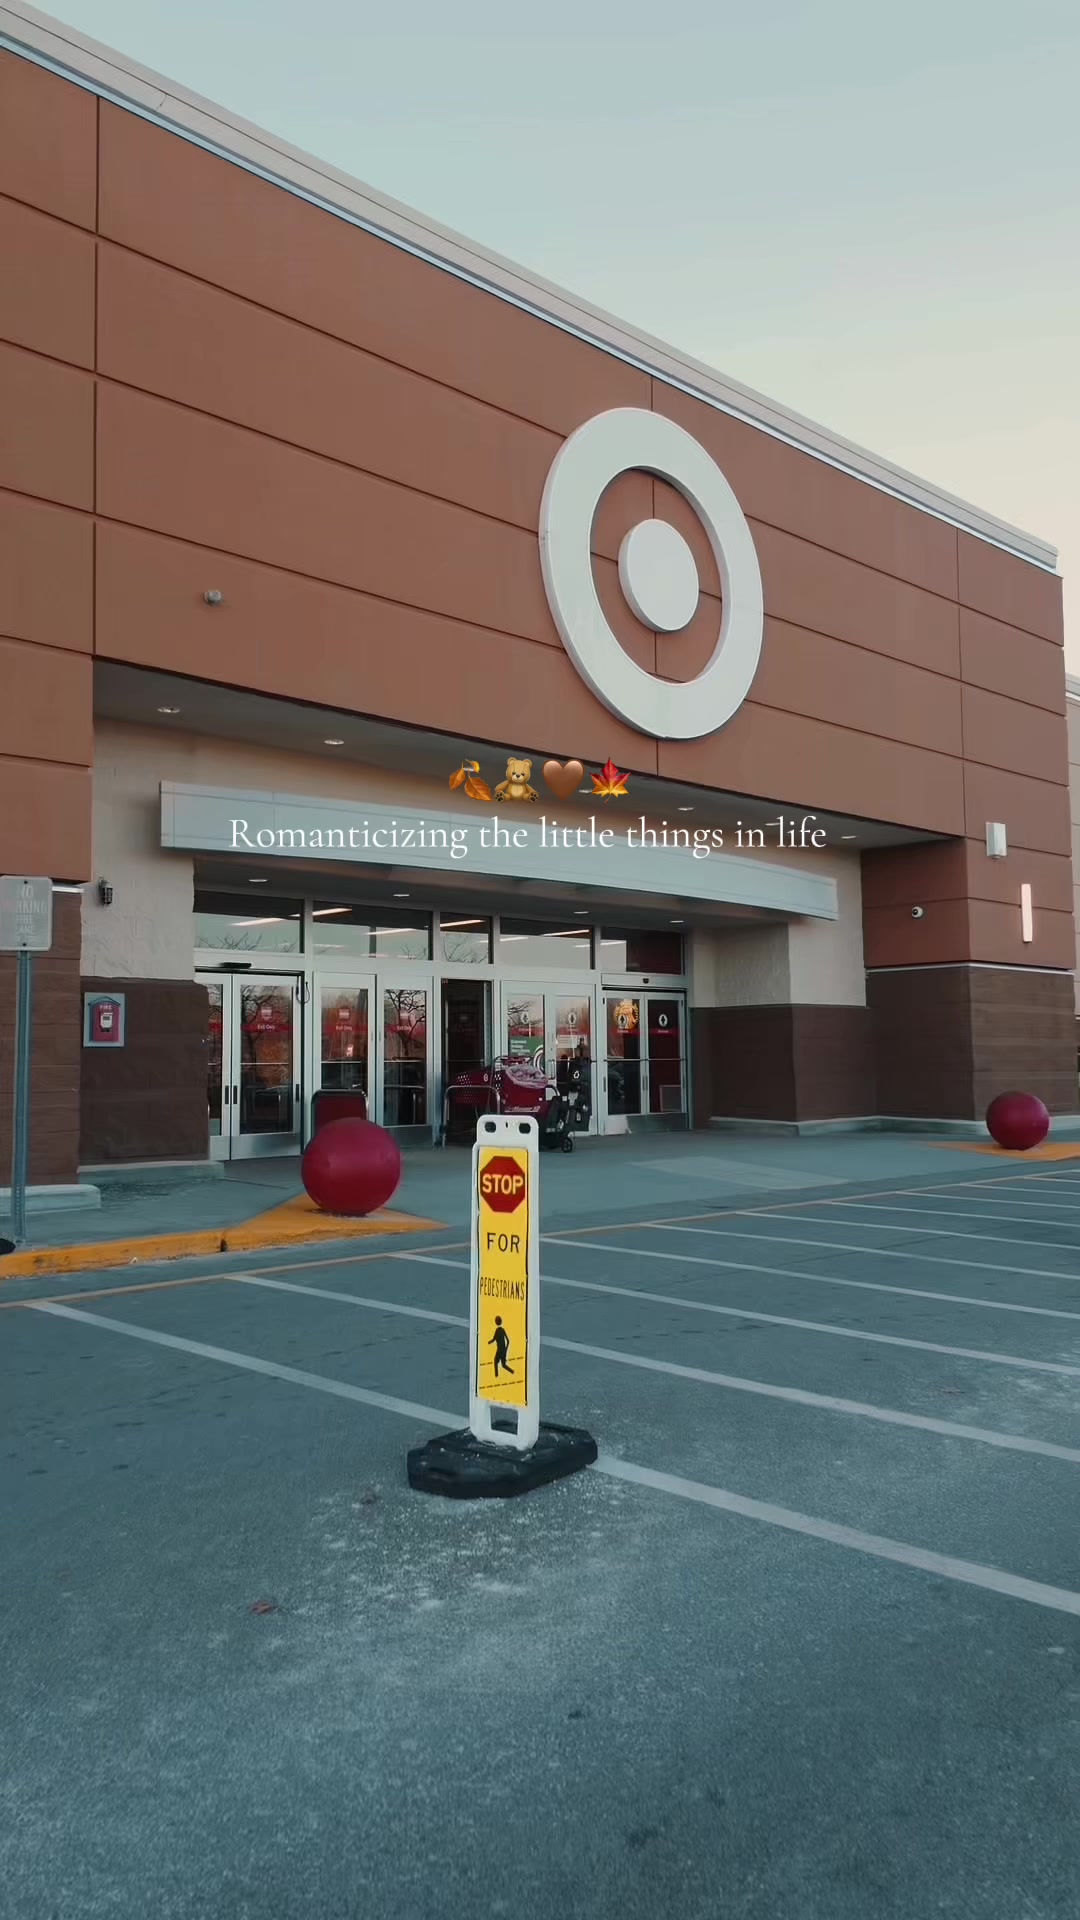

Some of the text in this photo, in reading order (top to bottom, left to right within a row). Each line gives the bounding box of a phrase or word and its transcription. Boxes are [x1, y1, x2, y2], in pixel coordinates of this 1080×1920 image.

[482, 1173, 523, 1195] STOP
[487, 1232, 520, 1253] FOR
[480, 1276, 525, 1301] PEDESTRIANS
